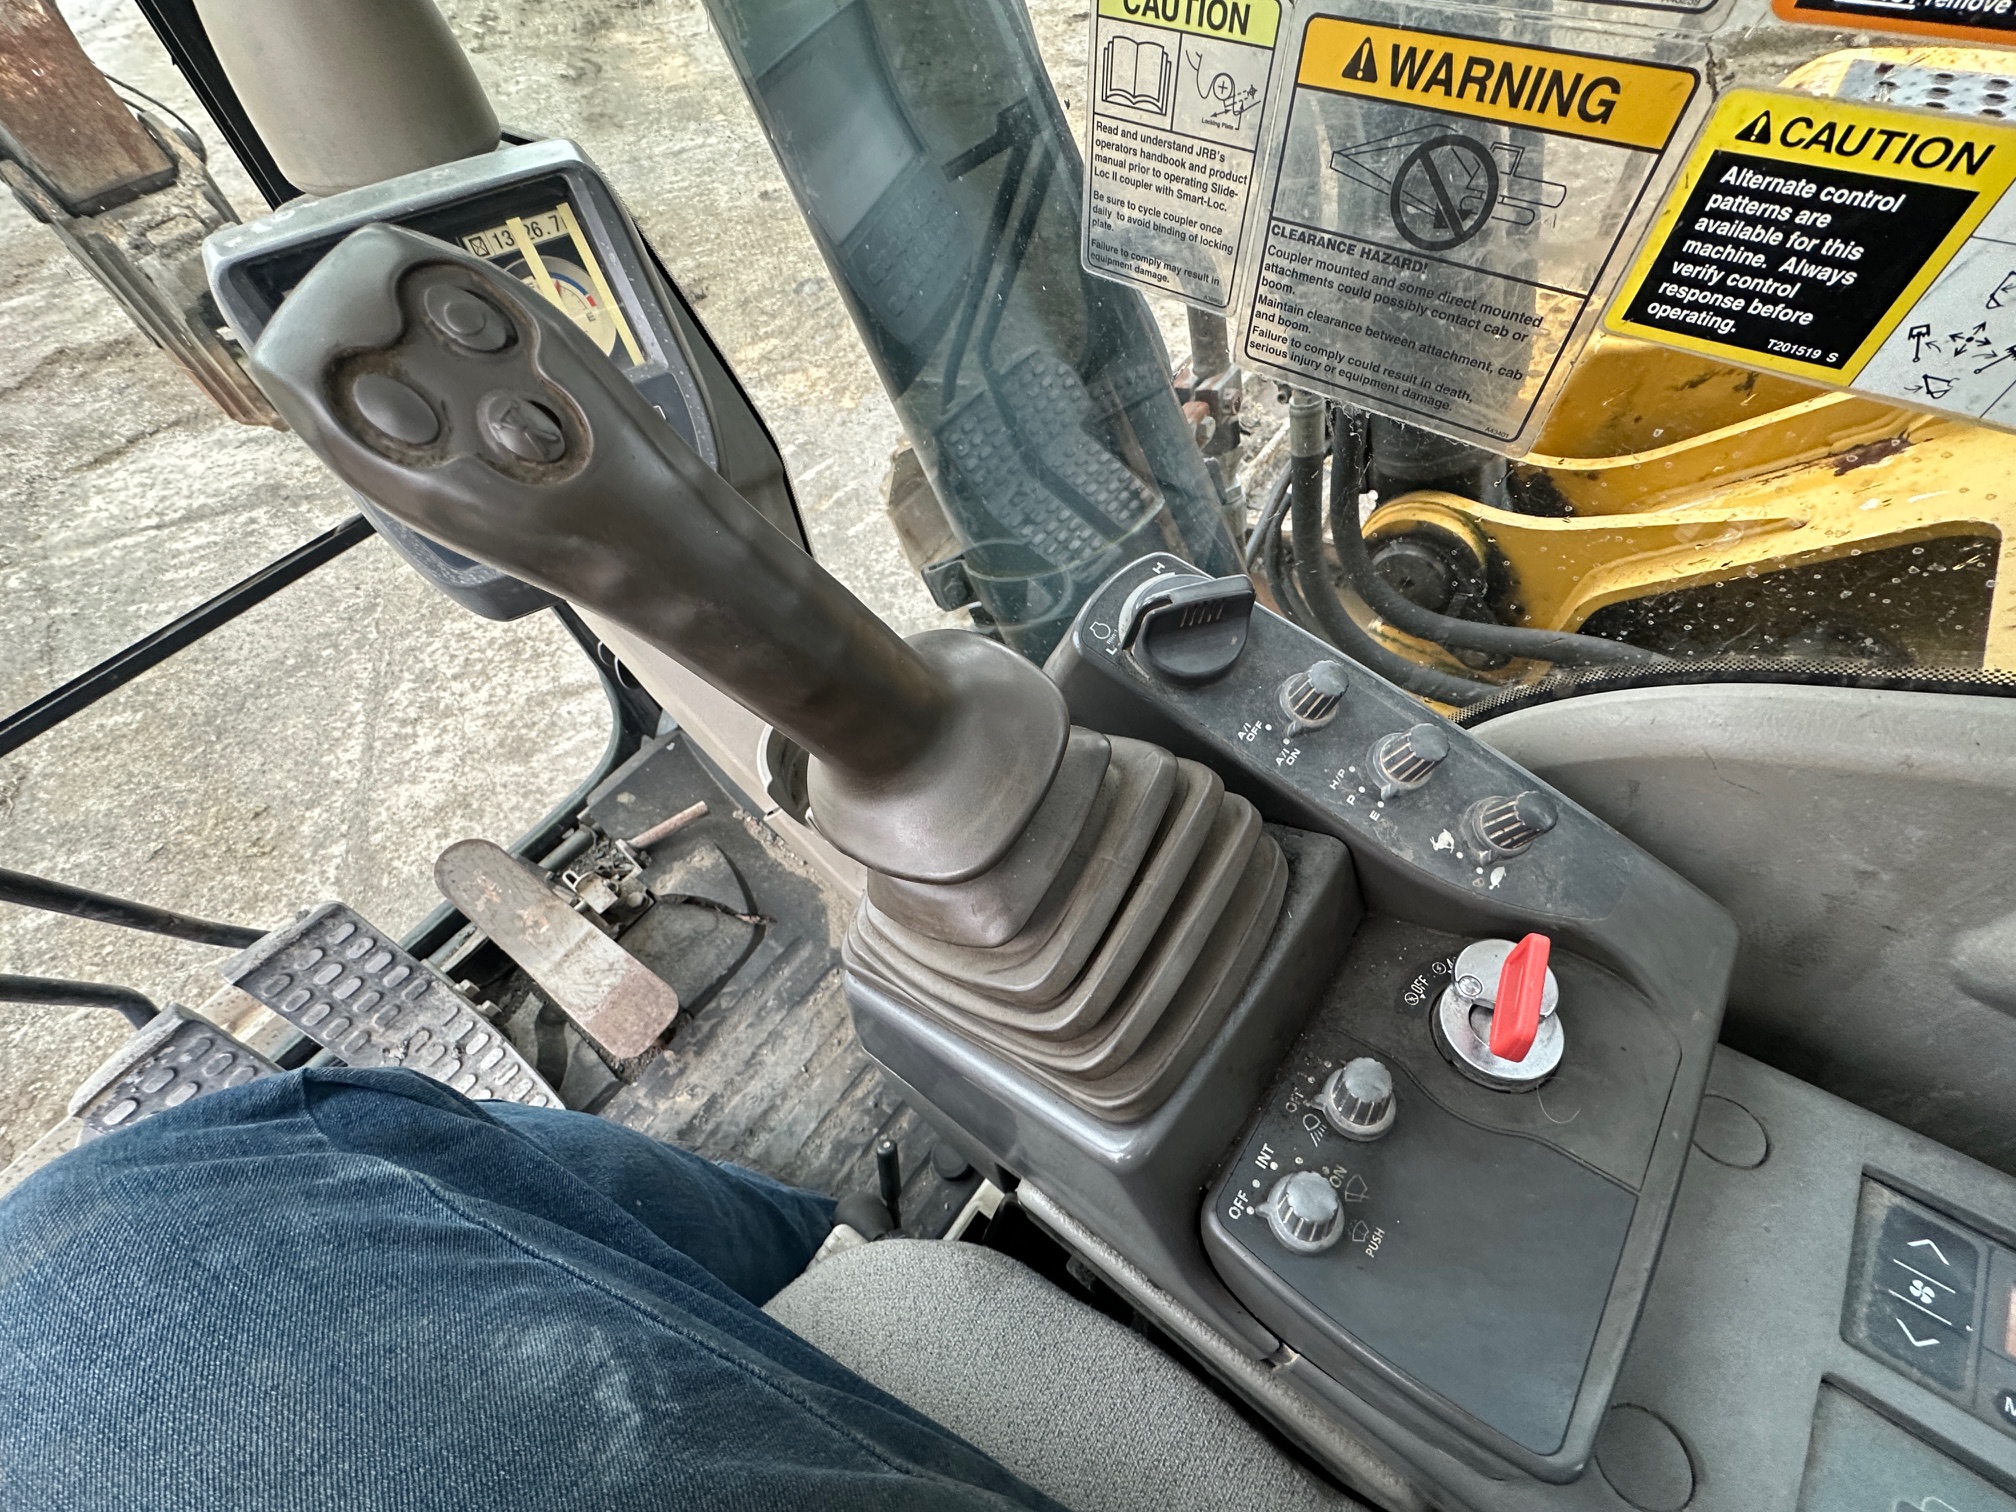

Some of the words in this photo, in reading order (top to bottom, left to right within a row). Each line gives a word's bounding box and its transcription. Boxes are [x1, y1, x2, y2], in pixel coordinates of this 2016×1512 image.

[1389, 43, 1621, 125] WARNING
[1202, 117, 1220, 128] Locking
[1096, 120, 1119, 136] Read
[1121, 129, 1138, 141] and
[1140, 134, 1194, 155] understand
[1196, 146, 1226, 163] JRB's
[1779, 116, 1996, 176] CAUTION
[1095, 139, 1138, 156] operators
[1140, 149, 1186, 168] handbook
[1189, 161, 1206, 174] and
[1209, 166, 1248, 186] product
[1095, 154, 1126, 169] manual
[1128, 163, 1150, 176] prior
[1152, 167, 1161, 178] to
[1164, 170, 1208, 193] operating
[1210, 183, 1238, 198] Slide-
[1094, 166, 1110, 179] Loc
[1120, 174, 1153, 191] coupler
[1155, 184, 1174, 197] with
[1176, 188, 1227, 212] Smart-Loc.
[1720, 166, 1818, 199] Alternate
[1822, 185, 1905, 214] control
[1092, 218, 1114, 232] plate.
[1094, 190, 1104, 200] Be
[1106, 196, 1126, 208] sure
[1127, 200, 1136, 210] to
[1138, 204, 1161, 218] cycle
[1163, 212, 1198, 228] coupler
[1200, 222, 1222, 236] once
[1704, 192, 1791, 226] patterns
[1794, 208, 1832, 229] are
[492, 214, 560, 250] 1326.7
[1092, 205, 1112, 219] daily
[1116, 212, 1125, 221] to
[1127, 215, 1150, 228] avoid
[1153, 222, 1186, 241] binding
[1188, 233, 1198, 242] of
[1200, 234, 1234, 255] locking
[1694, 217, 1783, 248] available
[1786, 233, 1820, 258] for
[1822, 240, 1864, 262] this
[1091, 239, 1118, 254] Failure
[1120, 246, 1128, 258] to
[1131, 252, 1162, 269] comply
[1164, 262, 1182, 275] may
[1184, 268, 1209, 282] result
[1211, 276, 1220, 286] in
[1271, 224, 1356, 256] CLEARANCE
[1360, 247, 1428, 274] HAZARD!
[1682, 237, 1767, 270] machine.
[1778, 256, 1858, 287] Always
[1090, 252, 1132, 272] equipment
[1134, 266, 1170, 284] damage.
[1262, 276, 1295, 294] boom.
[1268, 244, 1313, 266] Coupler
[1315, 258, 1370, 281] mounted
[1372, 274, 1396, 288] and
[1399, 282, 1434, 298] some
[1438, 290, 1476, 310] direct
[1479, 302, 1544, 328] mounted
[1671, 261, 1721, 288] verify
[1726, 270, 1801, 298] control
[1264, 262, 1334, 289] attachments
[1338, 281, 1372, 300] could
[1373, 292, 1427, 317] possibly
[1431, 307, 1481, 330] contact
[1484, 323, 1509, 338] cab
[1512, 331, 1528, 342] or
[1646, 301, 1736, 335] operating.
[1658, 283, 1745, 313] response
[1747, 303, 1813, 327] before
[1255, 310, 1275, 322] and
[1278, 316, 1311, 334] boom.
[1258, 294, 1304, 316] Maintain
[1307, 310, 1362, 334] clearance
[1365, 326, 1416, 350] between
[1419, 342, 1493, 373] attachment,
[1498, 366, 1523, 381] cab
[1252, 326, 1288, 344] Failure
[1290, 337, 1302, 348] to
[1304, 344, 1346, 363] comply
[1348, 356, 1380, 374] could
[1382, 366, 1418, 385] result
[1420, 376, 1432, 390] in
[1435, 383, 1472, 404] death,
[1766, 339, 1821, 360] T201519
[1250, 340, 1288, 358] serious
[1290, 352, 1322, 370] injury
[1324, 364, 1336, 374] or
[1338, 368, 1400, 394] equipment
[1402, 388, 1452, 411] damage.
[1152, 562, 1166, 574] H
[1238, 722, 1252, 740] A/I
[1246, 720, 1262, 742] OFF
[1276, 748, 1290, 766] A/I
[1286, 748, 1300, 766] ON
[1329, 768, 1346, 790] H/P
[1346, 794, 1356, 806] P
[1369, 810, 1380, 821] E
[1410, 974, 1429, 994] OFF
[1254, 1143, 1276, 1170] INT
[1330, 1164, 1348, 1188] ON
[1228, 1190, 1248, 1220] OFF
[1366, 1227, 1386, 1258] PUSH
